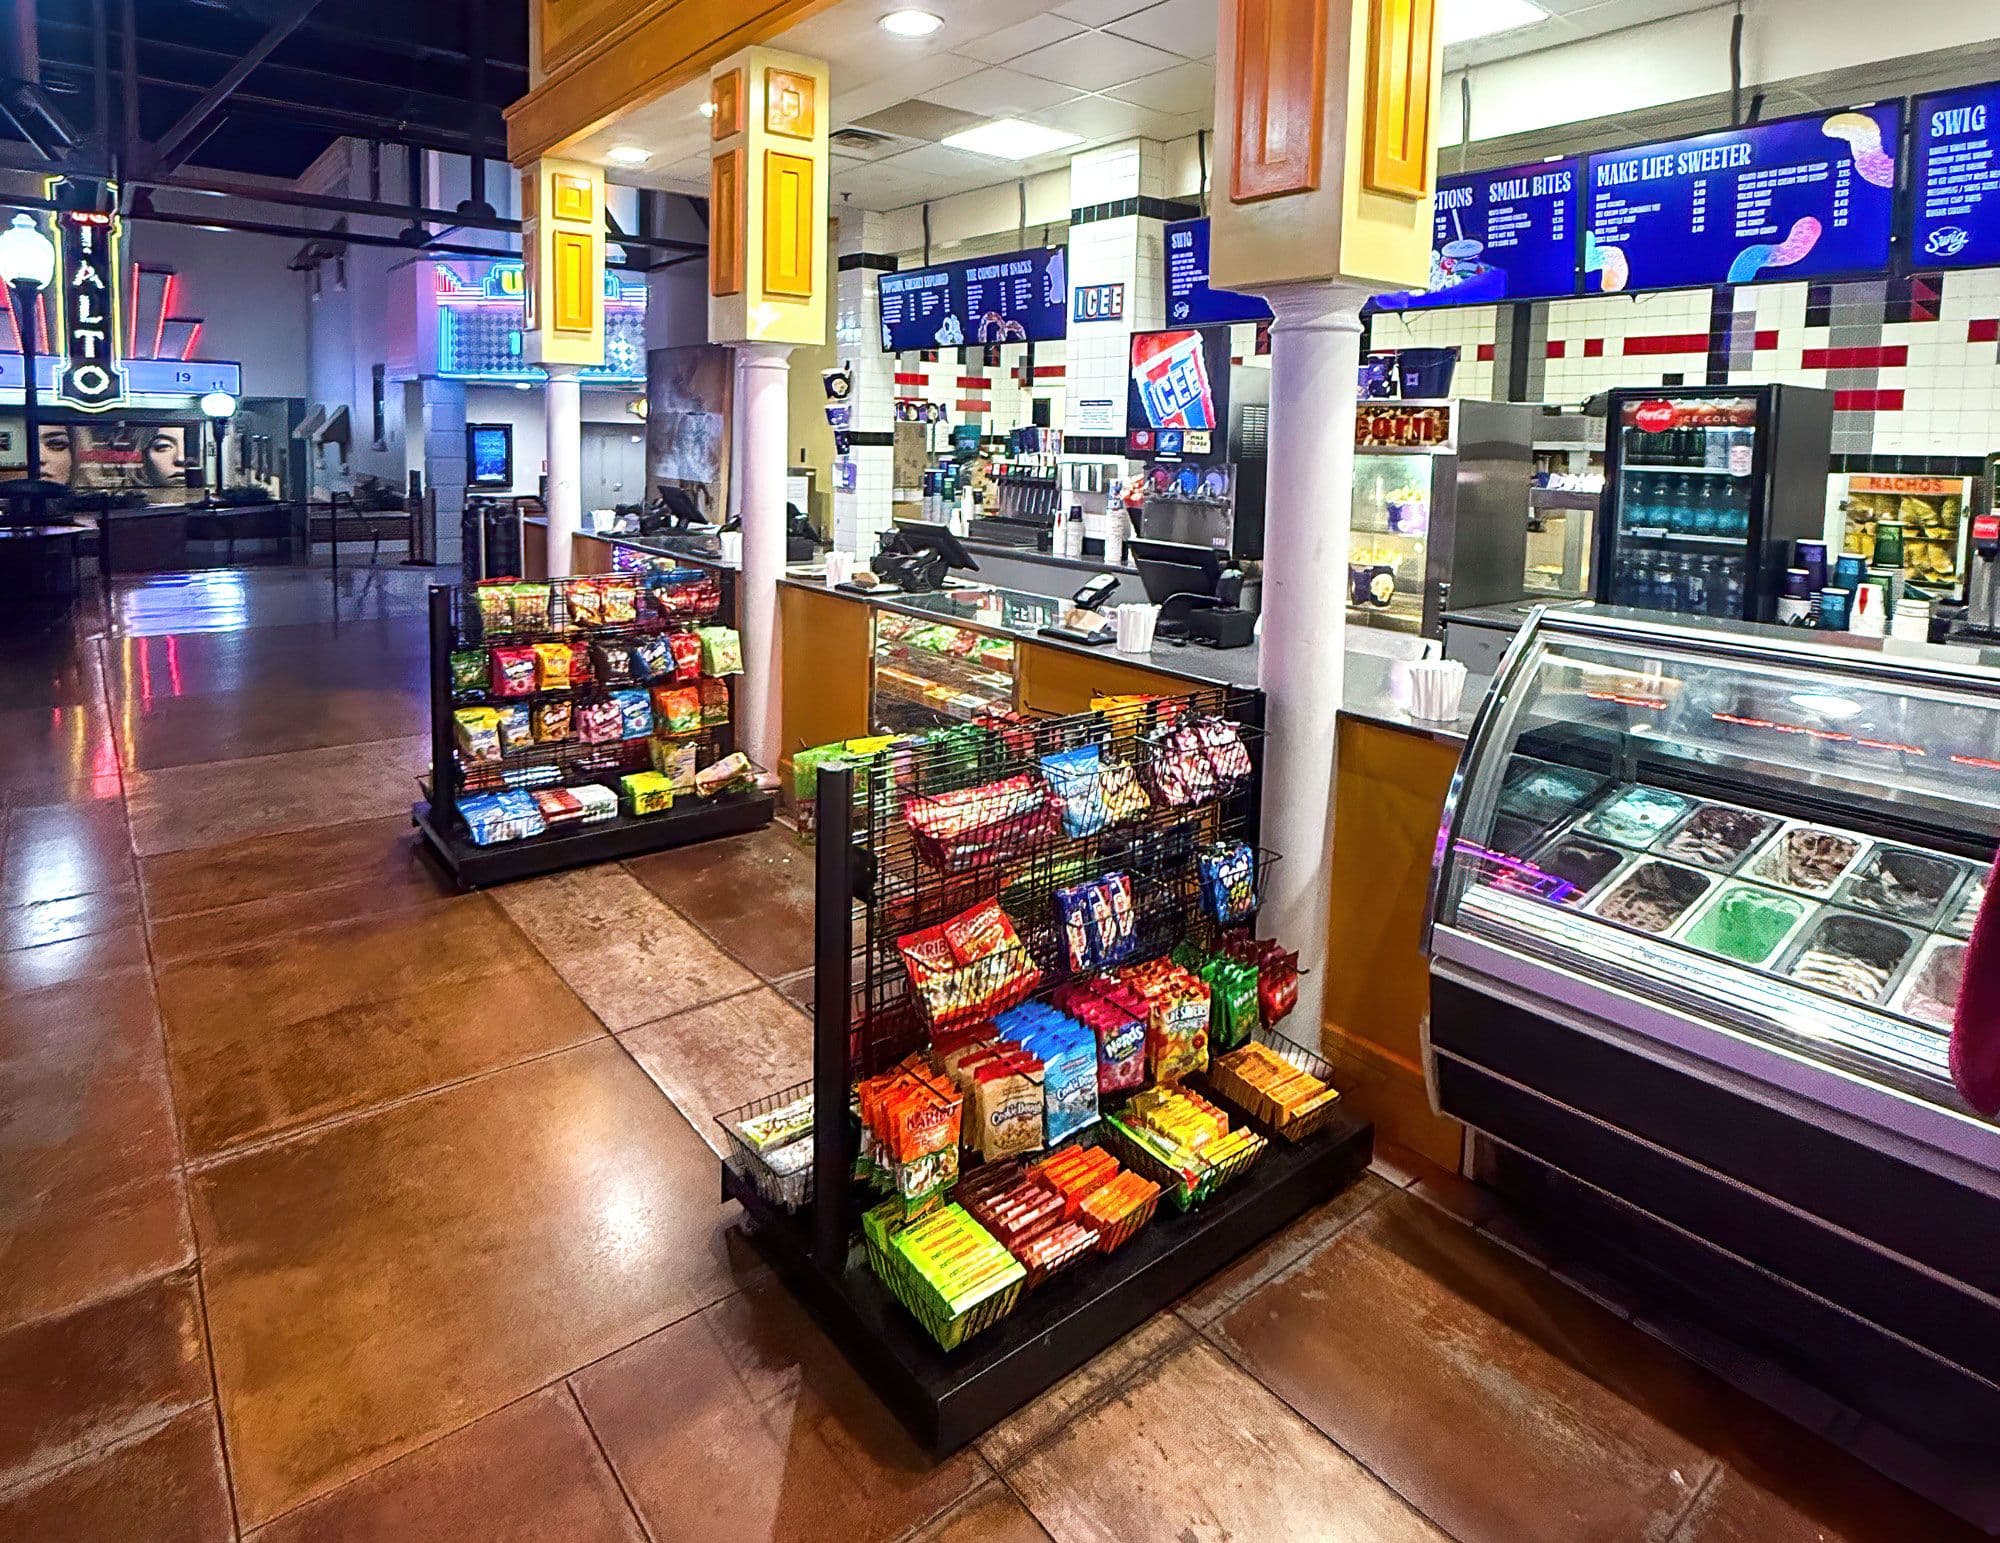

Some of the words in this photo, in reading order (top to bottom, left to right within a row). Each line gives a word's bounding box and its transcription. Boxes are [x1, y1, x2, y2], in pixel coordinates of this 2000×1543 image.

[1931, 104, 1987, 138] SWIG
[1597, 160, 1639, 188] MAKE
[1641, 153, 1675, 182] LIFE
[1677, 142, 1753, 176] SWEETER
[1489, 178, 1530, 203] SMALL
[1532, 171, 1572, 197] BITES
[1171, 230, 1193, 249] SWIG
[1009, 259, 1033, 276] SNACKS
[1076, 285, 1123, 318] ICEE
[176, 372, 192, 384] 19
[1146, 365, 1203, 422] ICEE
[1635, 407, 1673, 423] Coca-Cola
[1679, 415, 1699, 423] ICE
[1703, 415, 1738, 423] COLD
[1869, 476, 1945, 492] NACHOS
